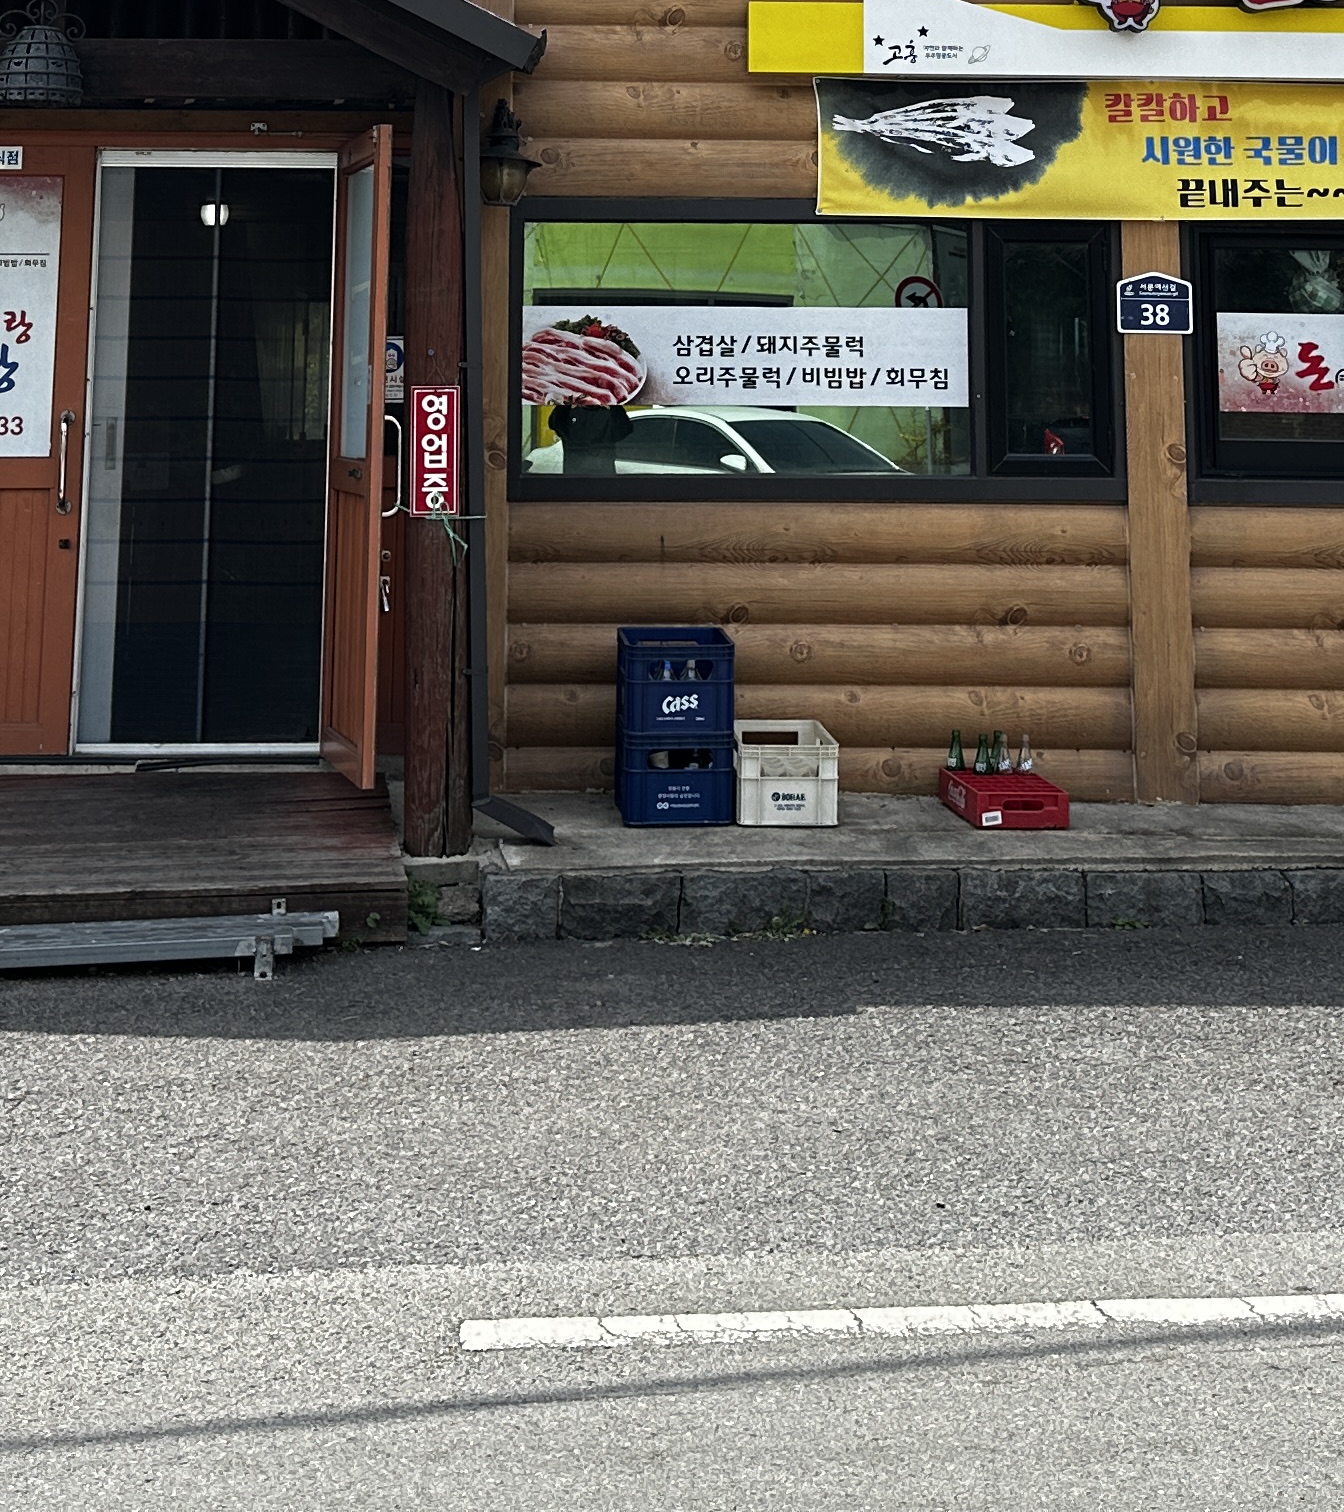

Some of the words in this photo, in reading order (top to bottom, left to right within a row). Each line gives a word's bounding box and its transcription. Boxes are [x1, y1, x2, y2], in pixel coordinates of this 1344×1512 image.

[1105, 92, 1232, 124] 칼칼하고
[1142, 135, 1235, 167] 시원한
[1246, 135, 1338, 167] 국물이
[1140, 304, 1170, 326] 38
[672, 334, 738, 357] 삼겹살
[755, 334, 865, 358] 돼지주물럭
[672, 365, 782, 389] 오리주물럭
[801, 365, 866, 389] 비빔밥
[886, 366, 950, 389] 회무침
[421, 395, 449, 510] 영업중
[662, 693, 699, 714] Cass
